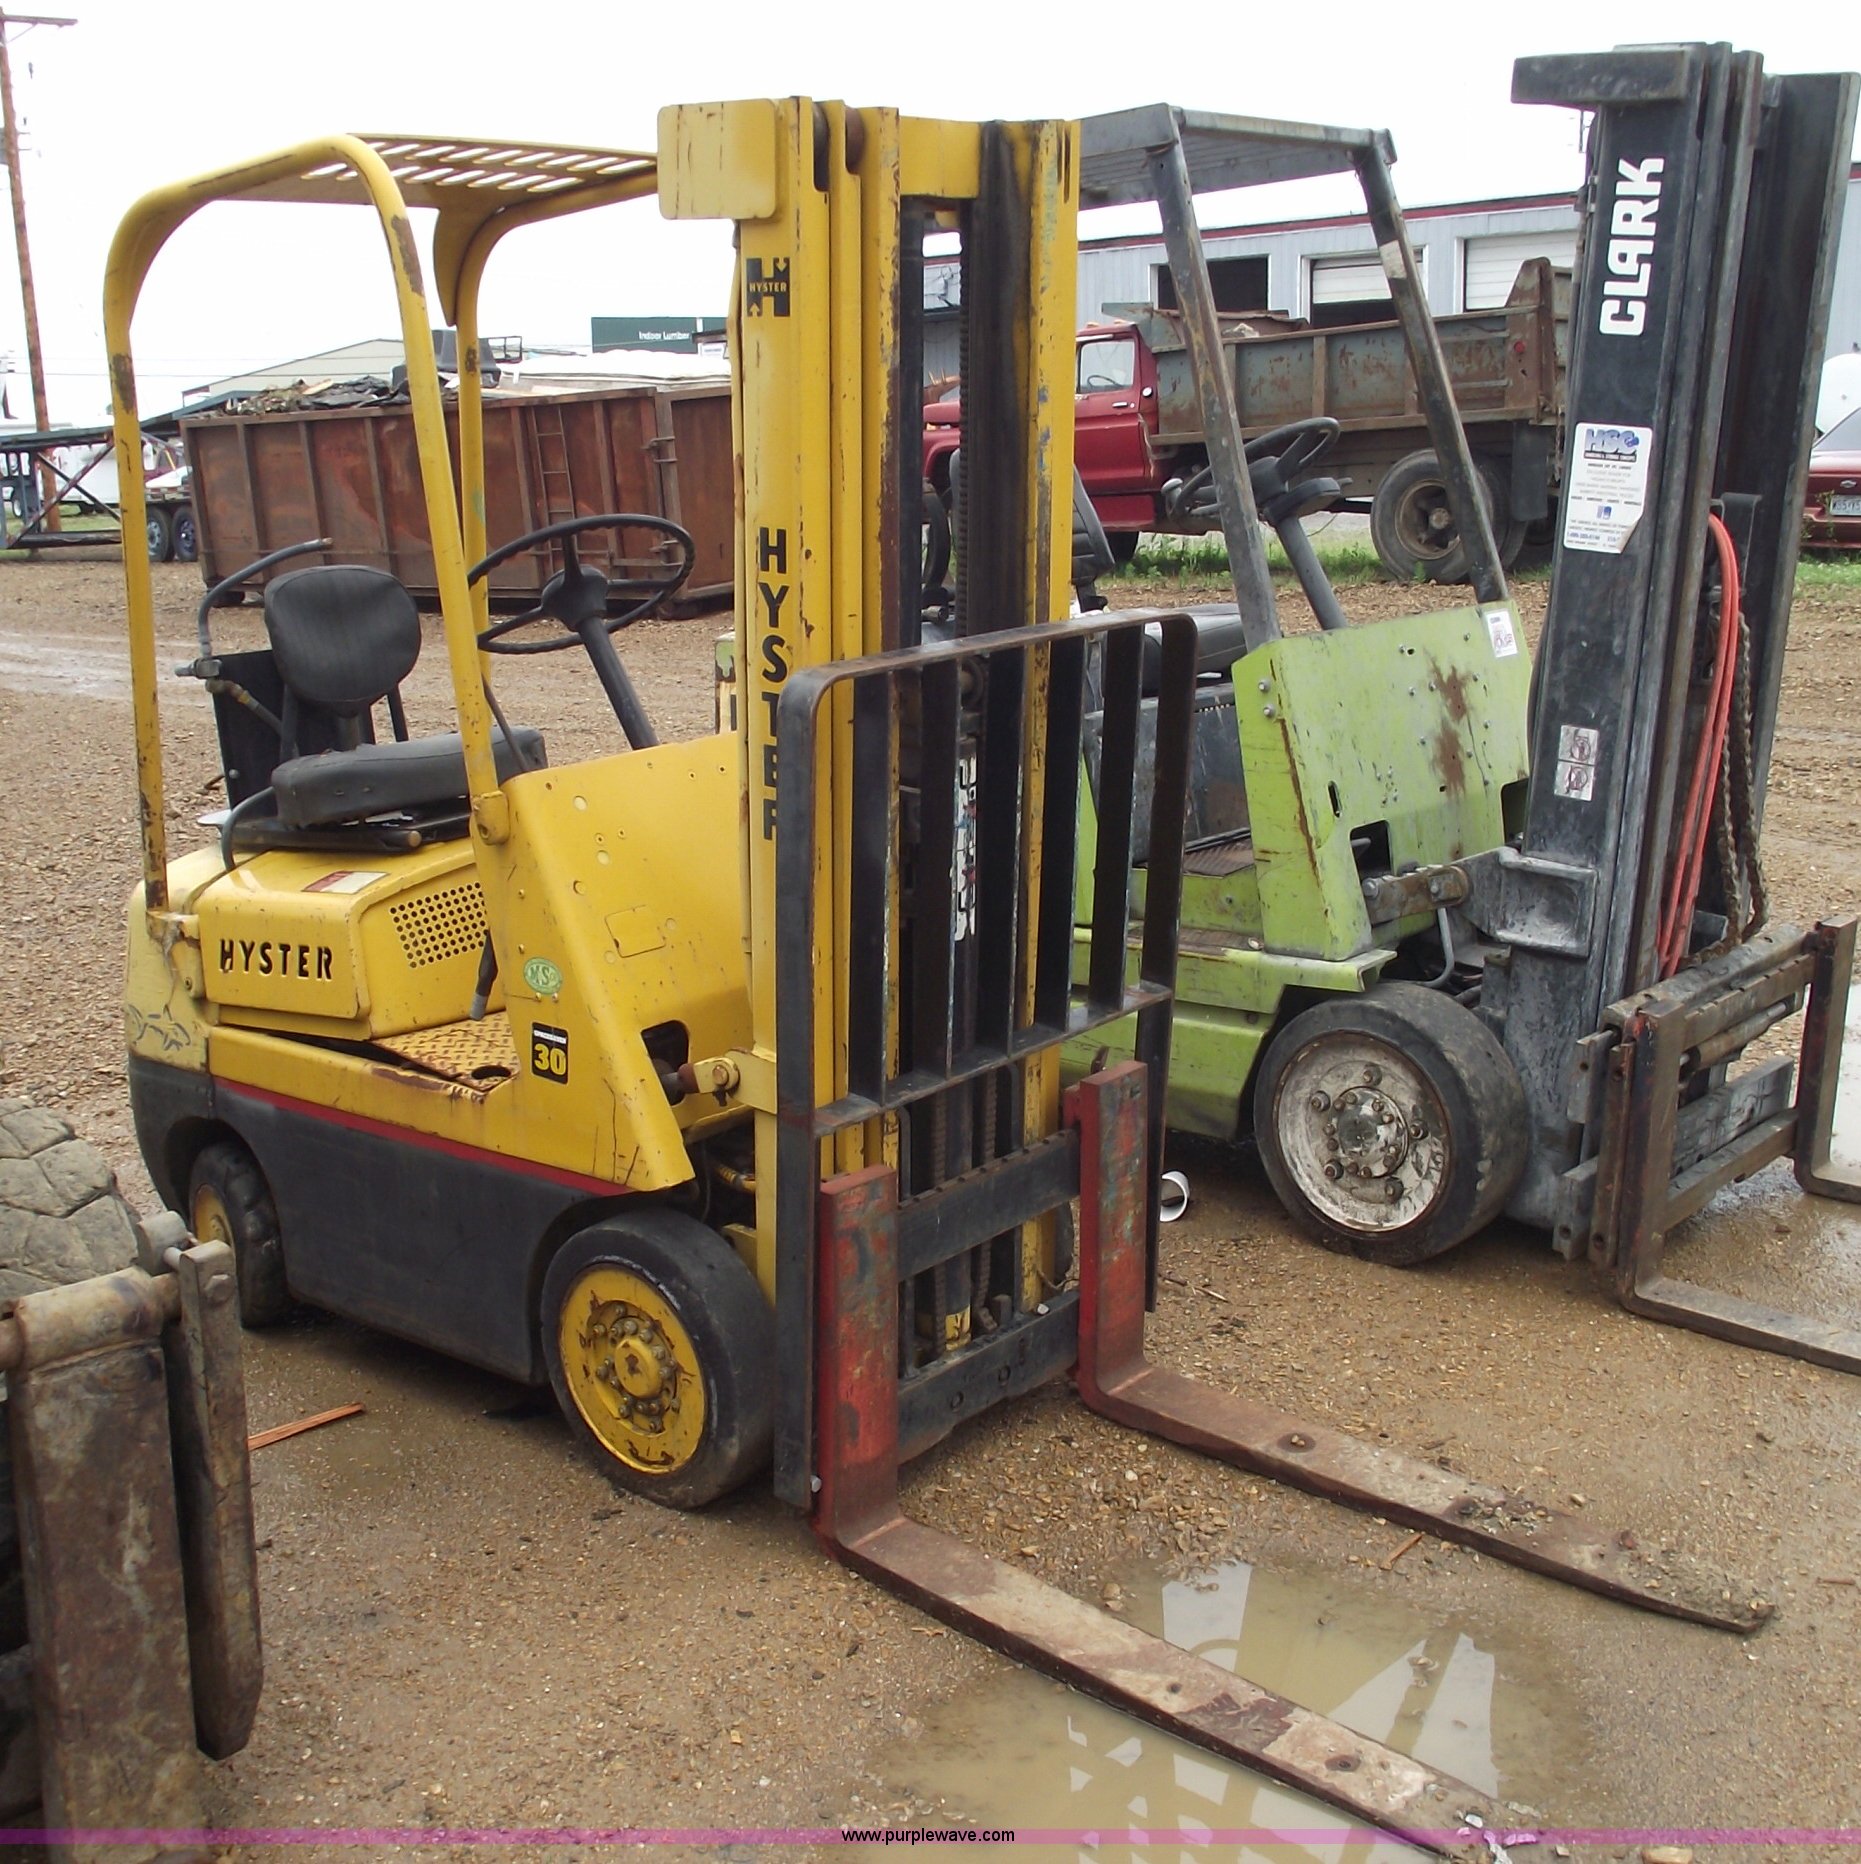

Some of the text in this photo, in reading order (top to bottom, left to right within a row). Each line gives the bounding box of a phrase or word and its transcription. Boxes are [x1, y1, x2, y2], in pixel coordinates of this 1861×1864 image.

[1599, 158, 1664, 336] CLARK
[749, 282, 787, 293] HYSTER
[663, 331, 690, 340] Lumber
[219, 939, 333, 980] HYSTER
[534, 1043, 567, 1076] 30
